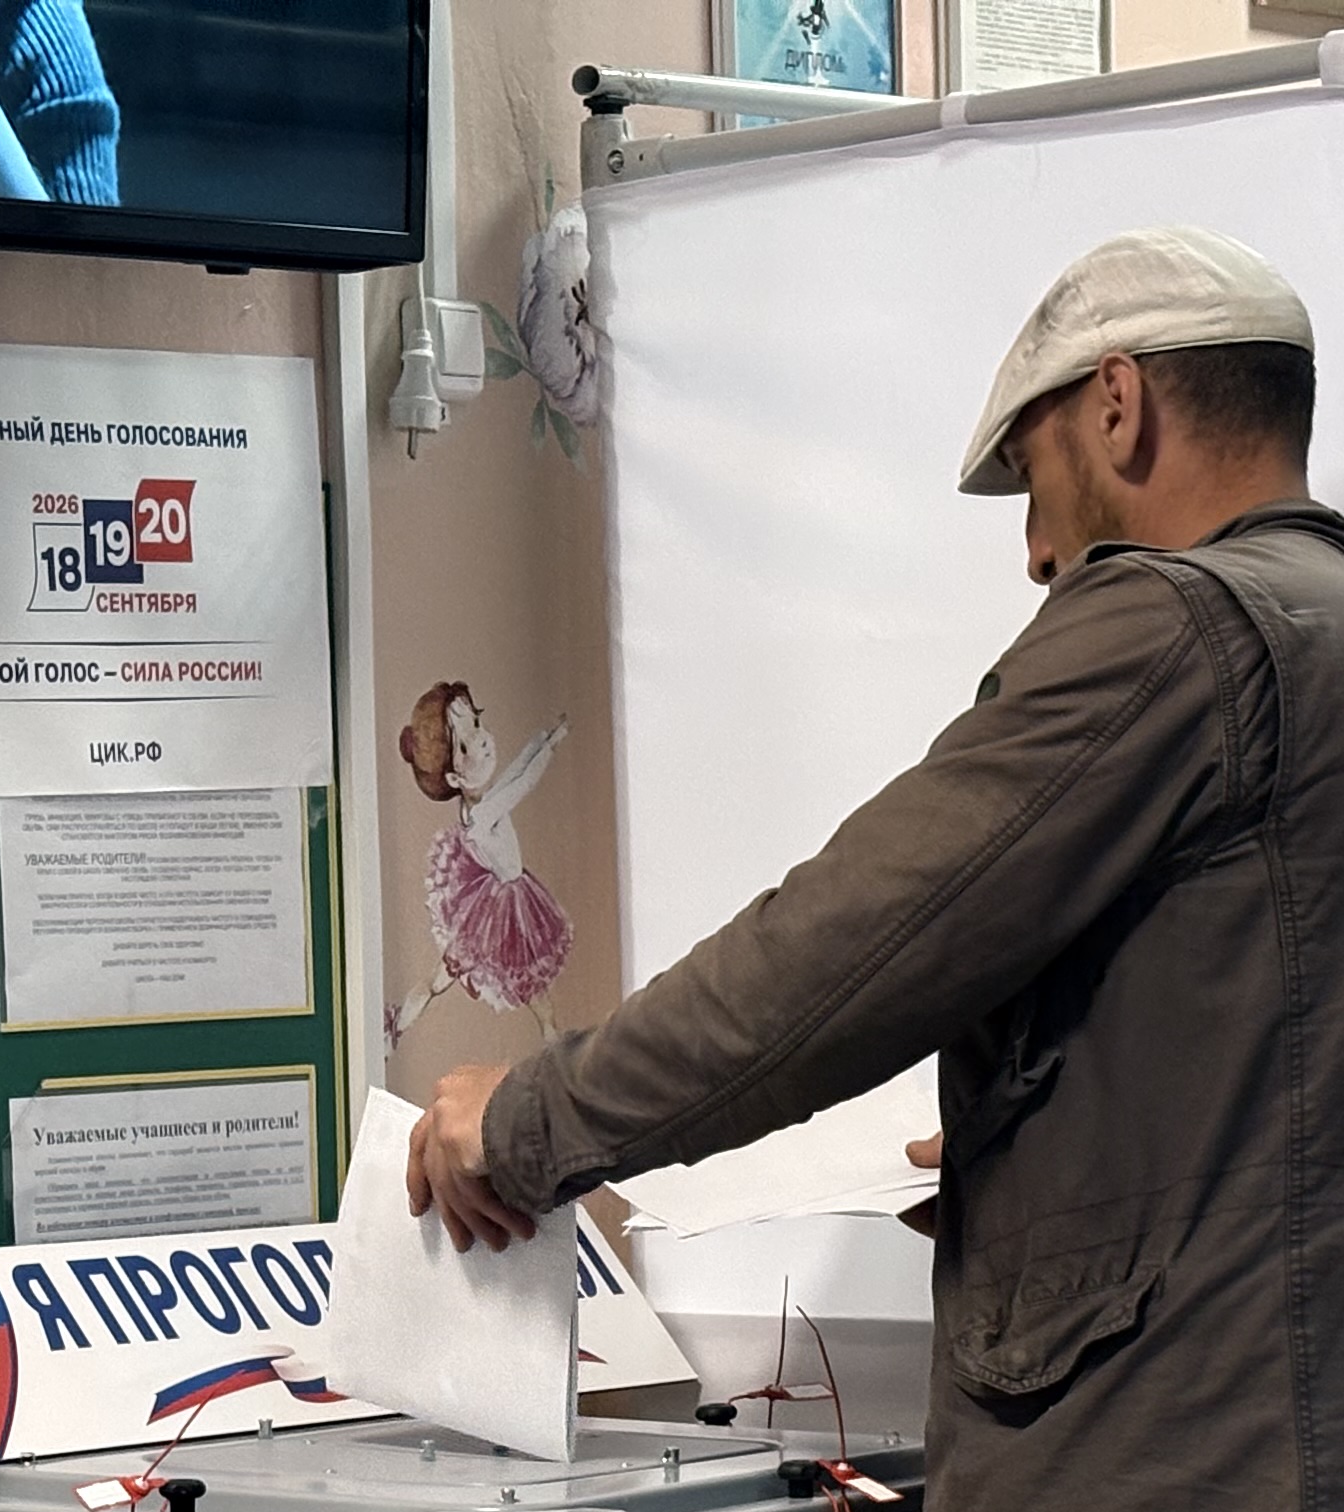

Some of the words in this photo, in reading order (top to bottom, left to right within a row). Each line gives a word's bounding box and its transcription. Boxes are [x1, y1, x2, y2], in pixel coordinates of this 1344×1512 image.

[50, 422, 102, 447] ДЕНЬ
[106, 423, 248, 450] ГОЛОСОВАНИЯ
[32, 494, 79, 515] 2026
[139, 498, 187, 544] 20
[88, 521, 131, 567] 19
[40, 546, 83, 592] 18
[95, 592, 198, 614] СЕНТЯБРЯ
[34, 661, 100, 684] ГОЛОС
[120, 660, 173, 683] СИЛА
[178, 660, 263, 682] РОССИИ!
[89, 741, 163, 765] ЦИК.РФ
[25, 853, 89, 866] УВАЖАЕМЫЕ
[91, 852, 146, 866] РОДИТЕЛИ!
[33, 1127, 127, 1147] Уважаемые
[131, 1121, 207, 1145] учащиеся
[212, 1121, 221, 1133] и
[225, 1110, 299, 1138] родители!
[12, 1263, 92, 1352] Я
